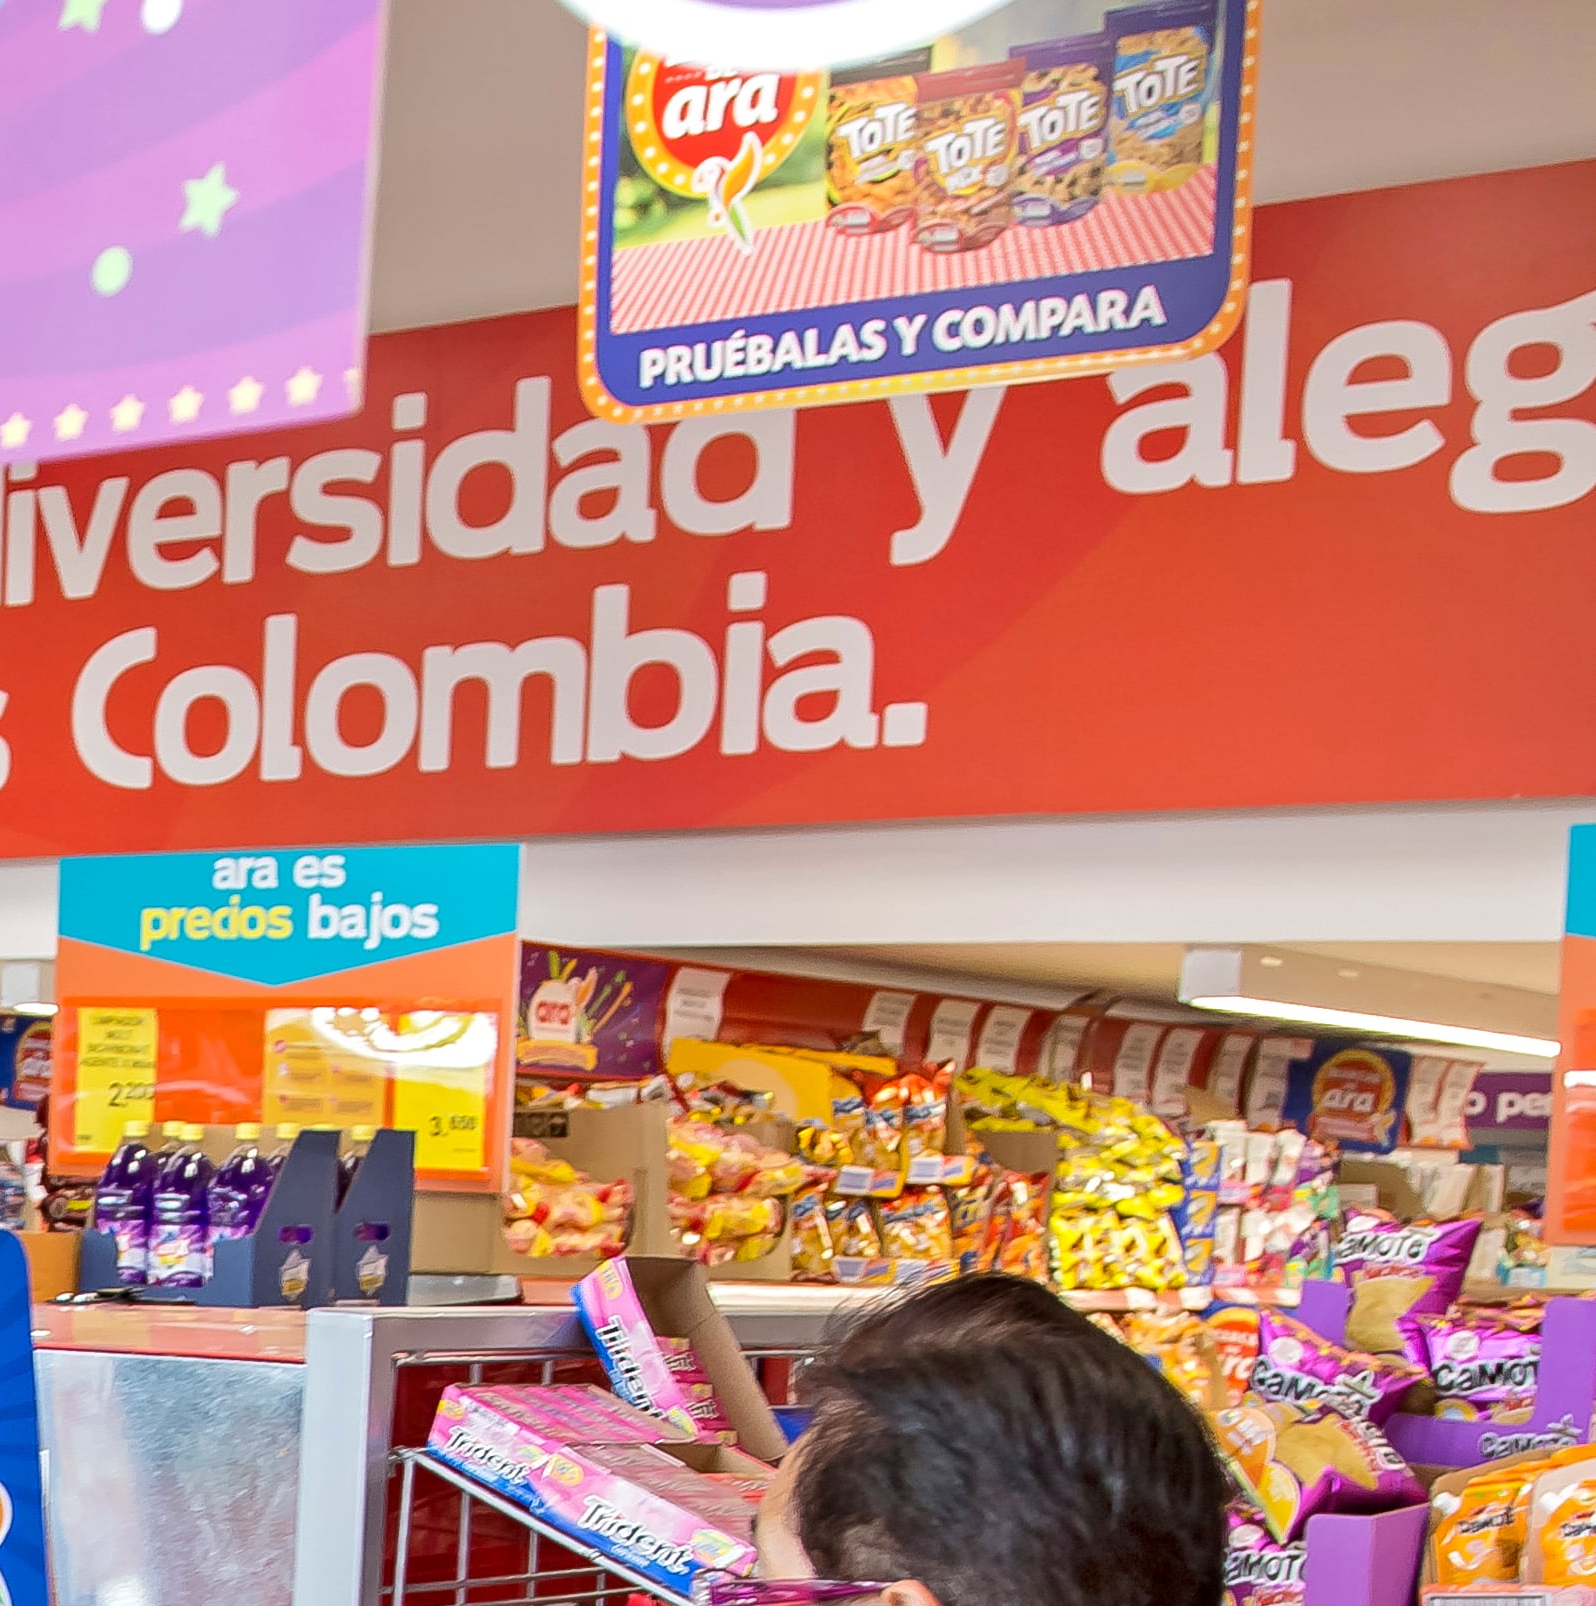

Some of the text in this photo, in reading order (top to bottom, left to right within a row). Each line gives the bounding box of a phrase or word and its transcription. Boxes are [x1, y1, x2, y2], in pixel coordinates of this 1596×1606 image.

[662, 70, 778, 140] ara
[1020, 88, 1102, 149] TOTE
[1114, 54, 1202, 117] TOTE
[925, 115, 1008, 167] TOTE
[638, 284, 1168, 389] PRUÉBALAS Y COMPARA
[1100, 279, 1596, 516] aleg
[887, 386, 1006, 567] y
[70, 571, 929, 791] Colombia.
[212, 854, 347, 891] ara es
[139, 891, 440, 952] precios bajos
[578, 1495, 693, 1576] Trident
